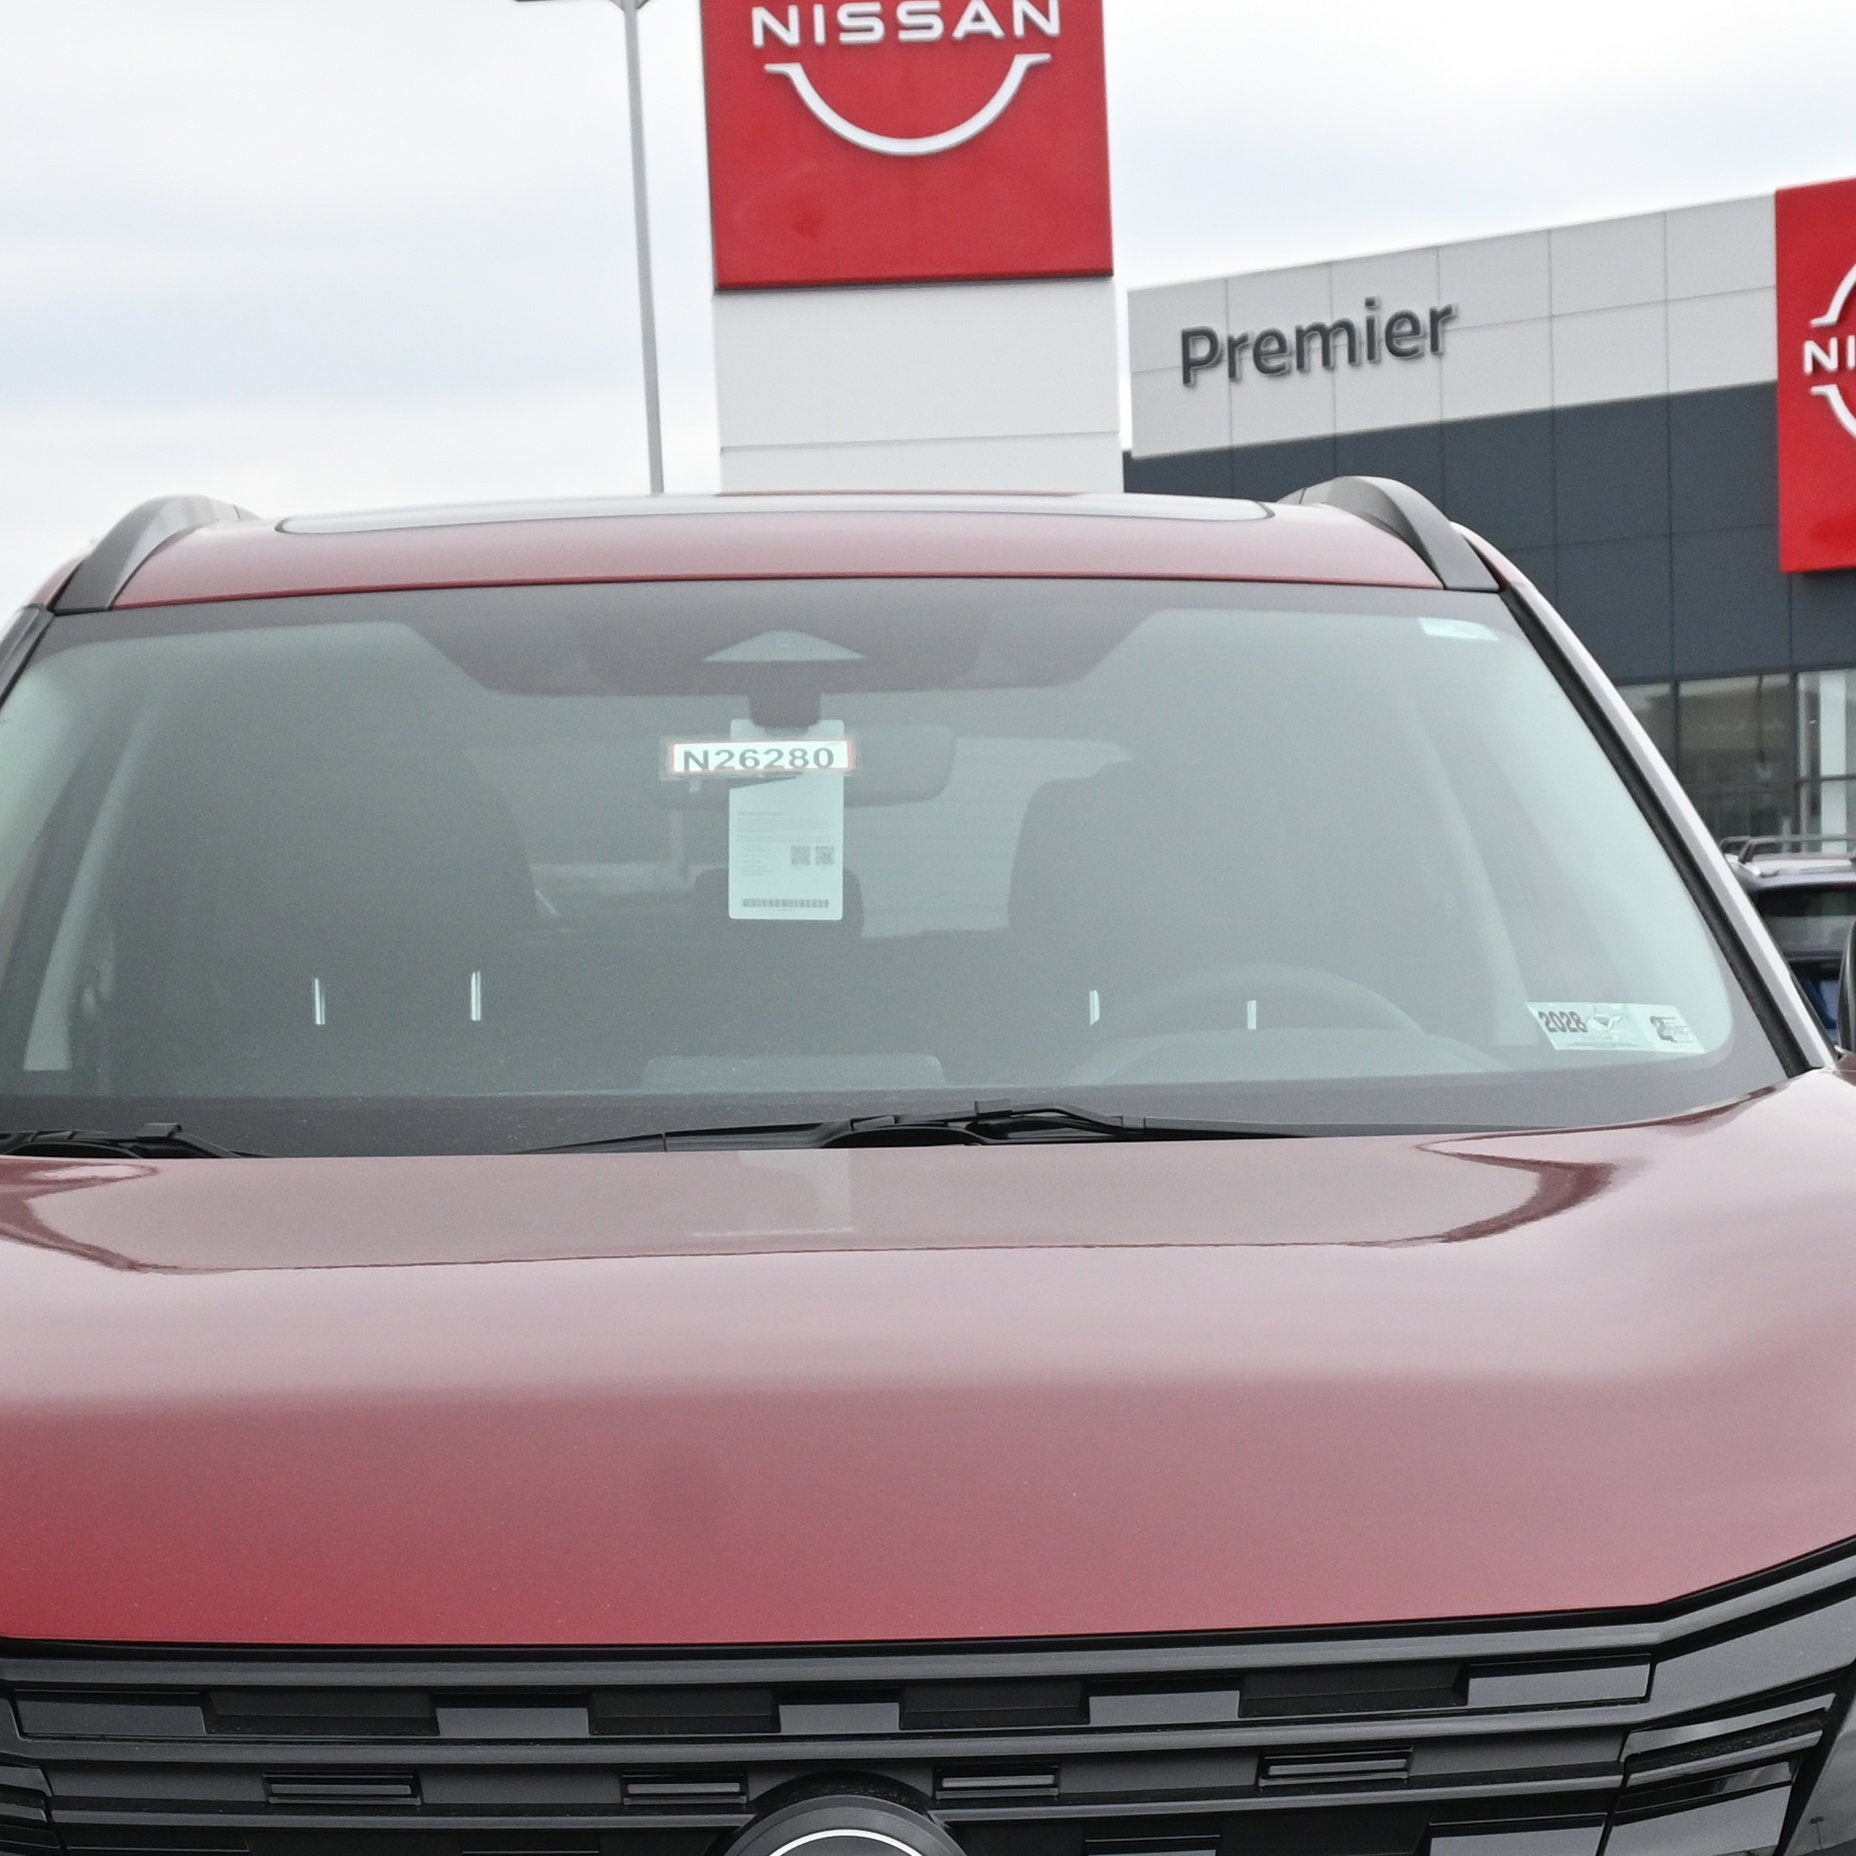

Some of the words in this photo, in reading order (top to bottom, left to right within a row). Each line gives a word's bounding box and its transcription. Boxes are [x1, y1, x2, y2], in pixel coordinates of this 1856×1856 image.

[752, 0, 1061, 48] NISSAN
[1180, 297, 1457, 388] Premier
[683, 747, 834, 771] N26280
[1537, 1011, 1588, 1033] 2028
